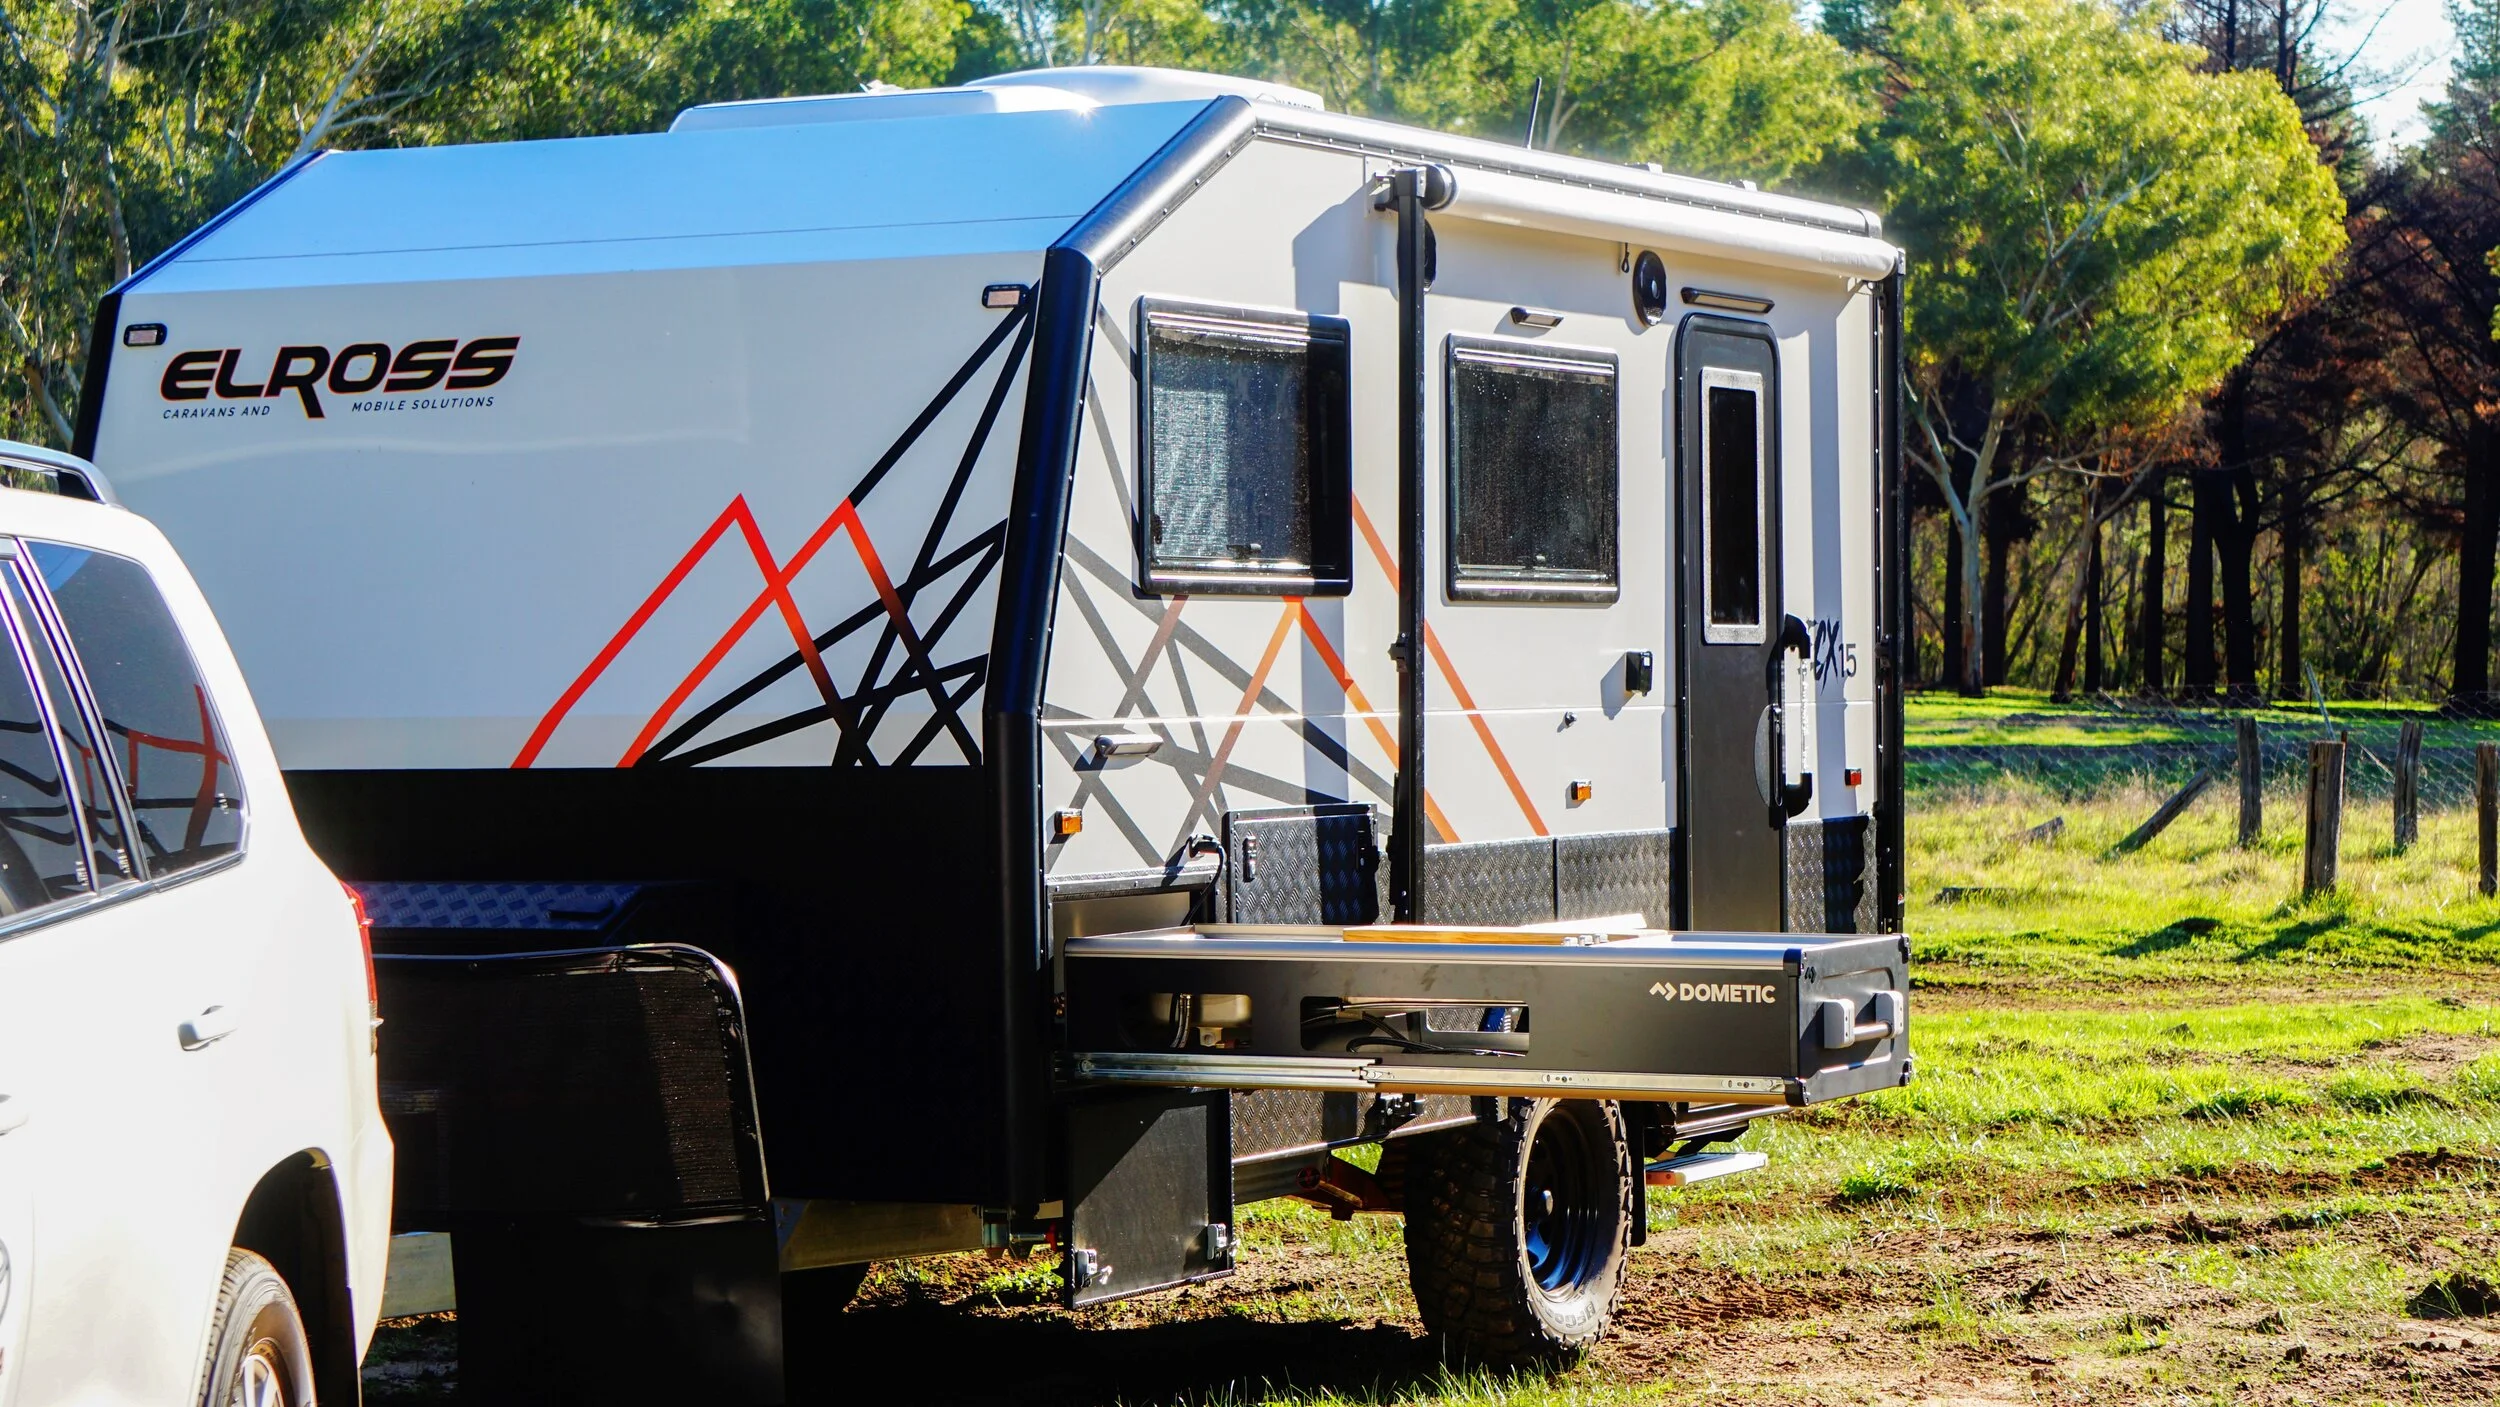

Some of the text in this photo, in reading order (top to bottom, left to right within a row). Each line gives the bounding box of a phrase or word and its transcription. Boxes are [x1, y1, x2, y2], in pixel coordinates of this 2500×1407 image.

[160, 335, 521, 419] ELROSS
[163, 395, 495, 420] CARAVANS AND MOBILE SOLUTIONS
[1680, 983, 1776, 1004] DOMETIC
